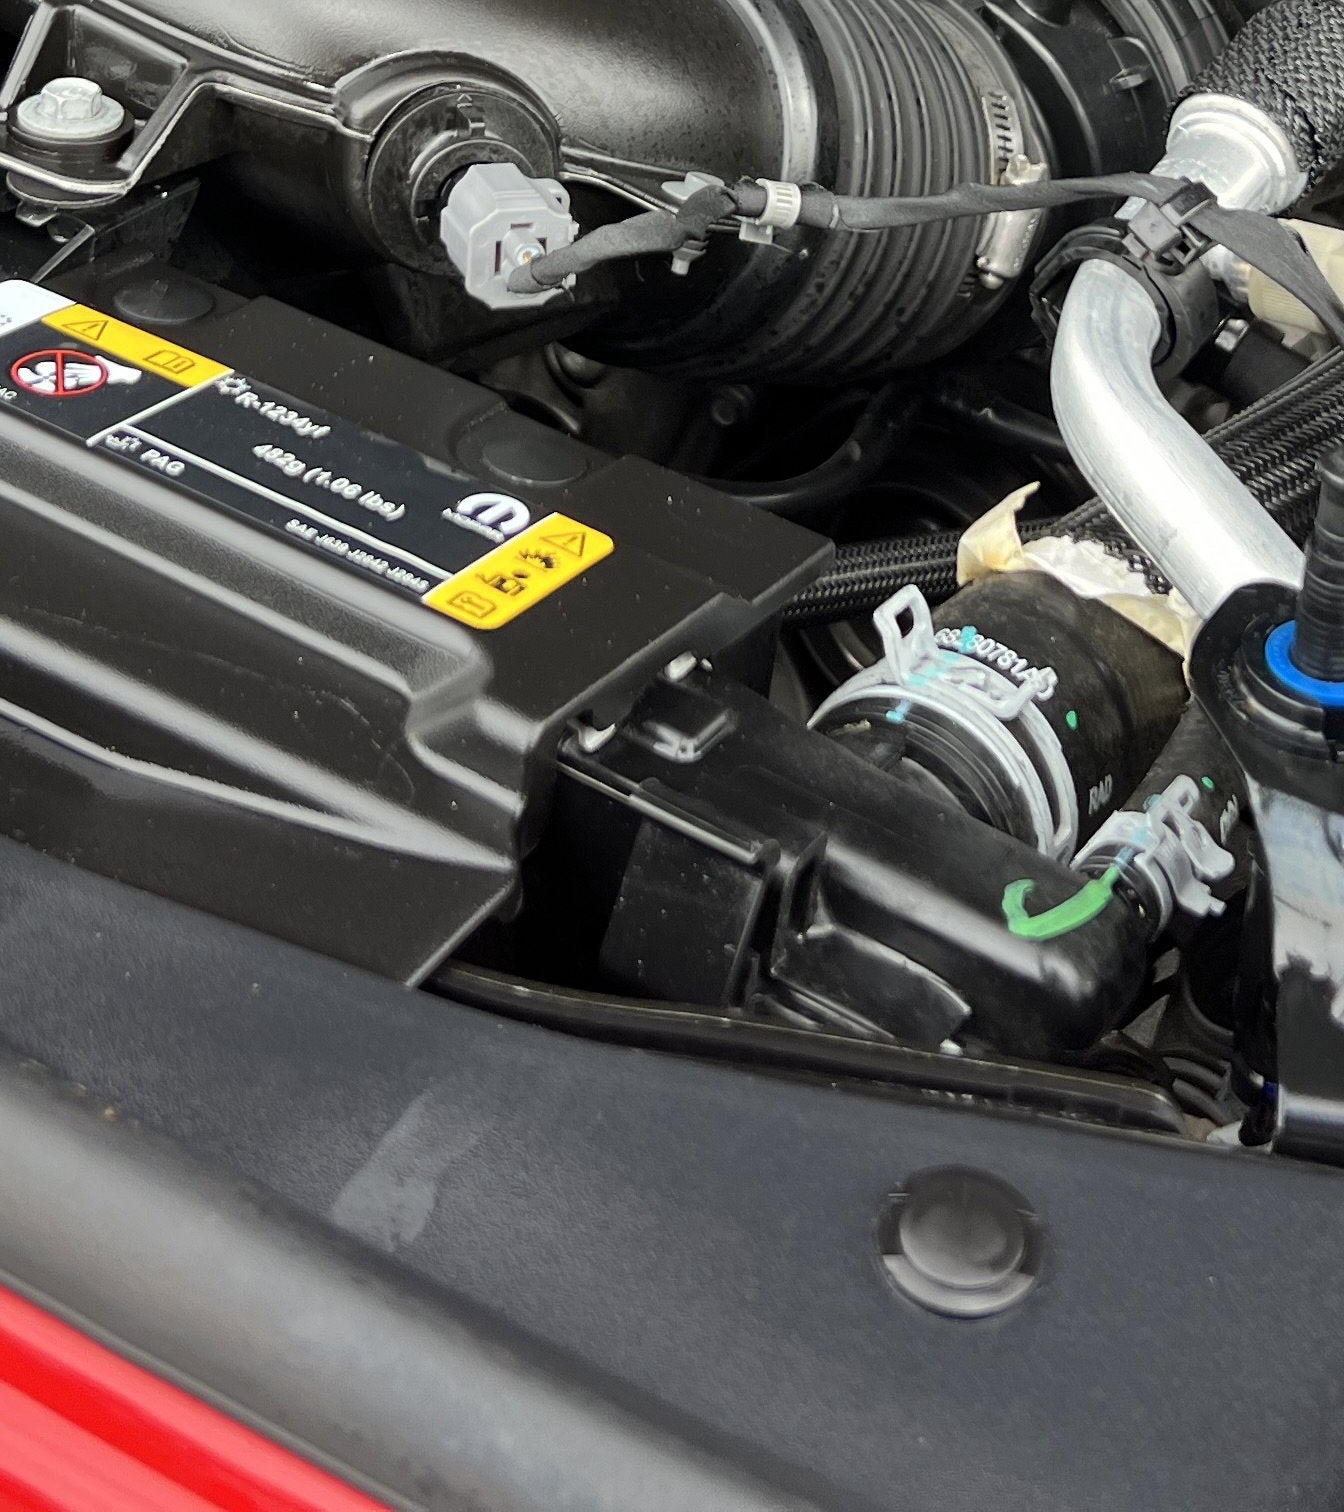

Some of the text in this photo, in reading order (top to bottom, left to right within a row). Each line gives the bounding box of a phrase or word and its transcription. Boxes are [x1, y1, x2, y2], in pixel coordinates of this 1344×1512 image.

[235, 391, 331, 439] R-1234yf
[140, 448, 186, 477] PAG
[302, 466, 362, 500] (1.06
[359, 490, 406, 522] lbs)
[285, 518, 319, 541] SAE
